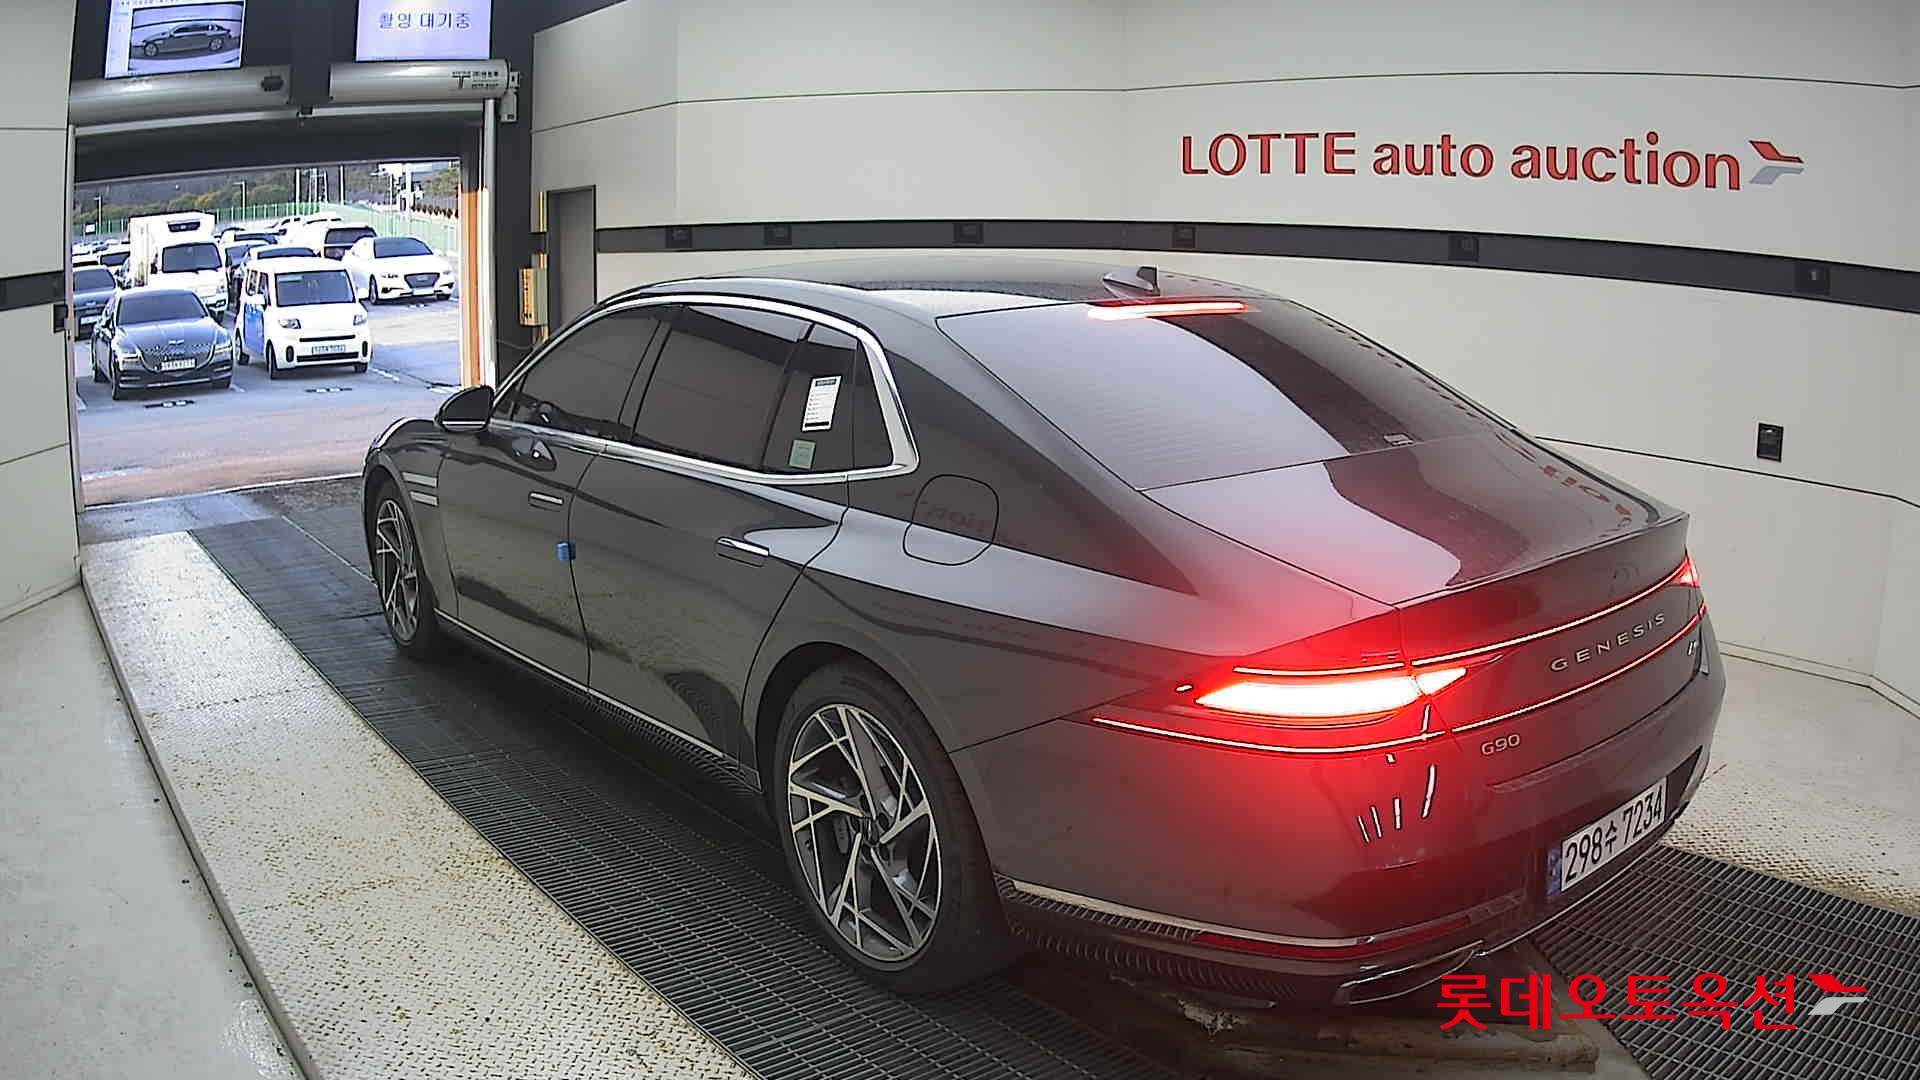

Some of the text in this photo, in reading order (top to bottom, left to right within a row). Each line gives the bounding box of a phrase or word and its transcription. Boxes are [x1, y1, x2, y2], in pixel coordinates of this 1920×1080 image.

[419, 11, 471, 29] 대기중
[1180, 131, 1743, 191] LOTTE auto auction
[1549, 612, 1666, 672] GENESIS
[1480, 733, 1522, 757] G90
[1563, 785, 1664, 884] 298수 7234
